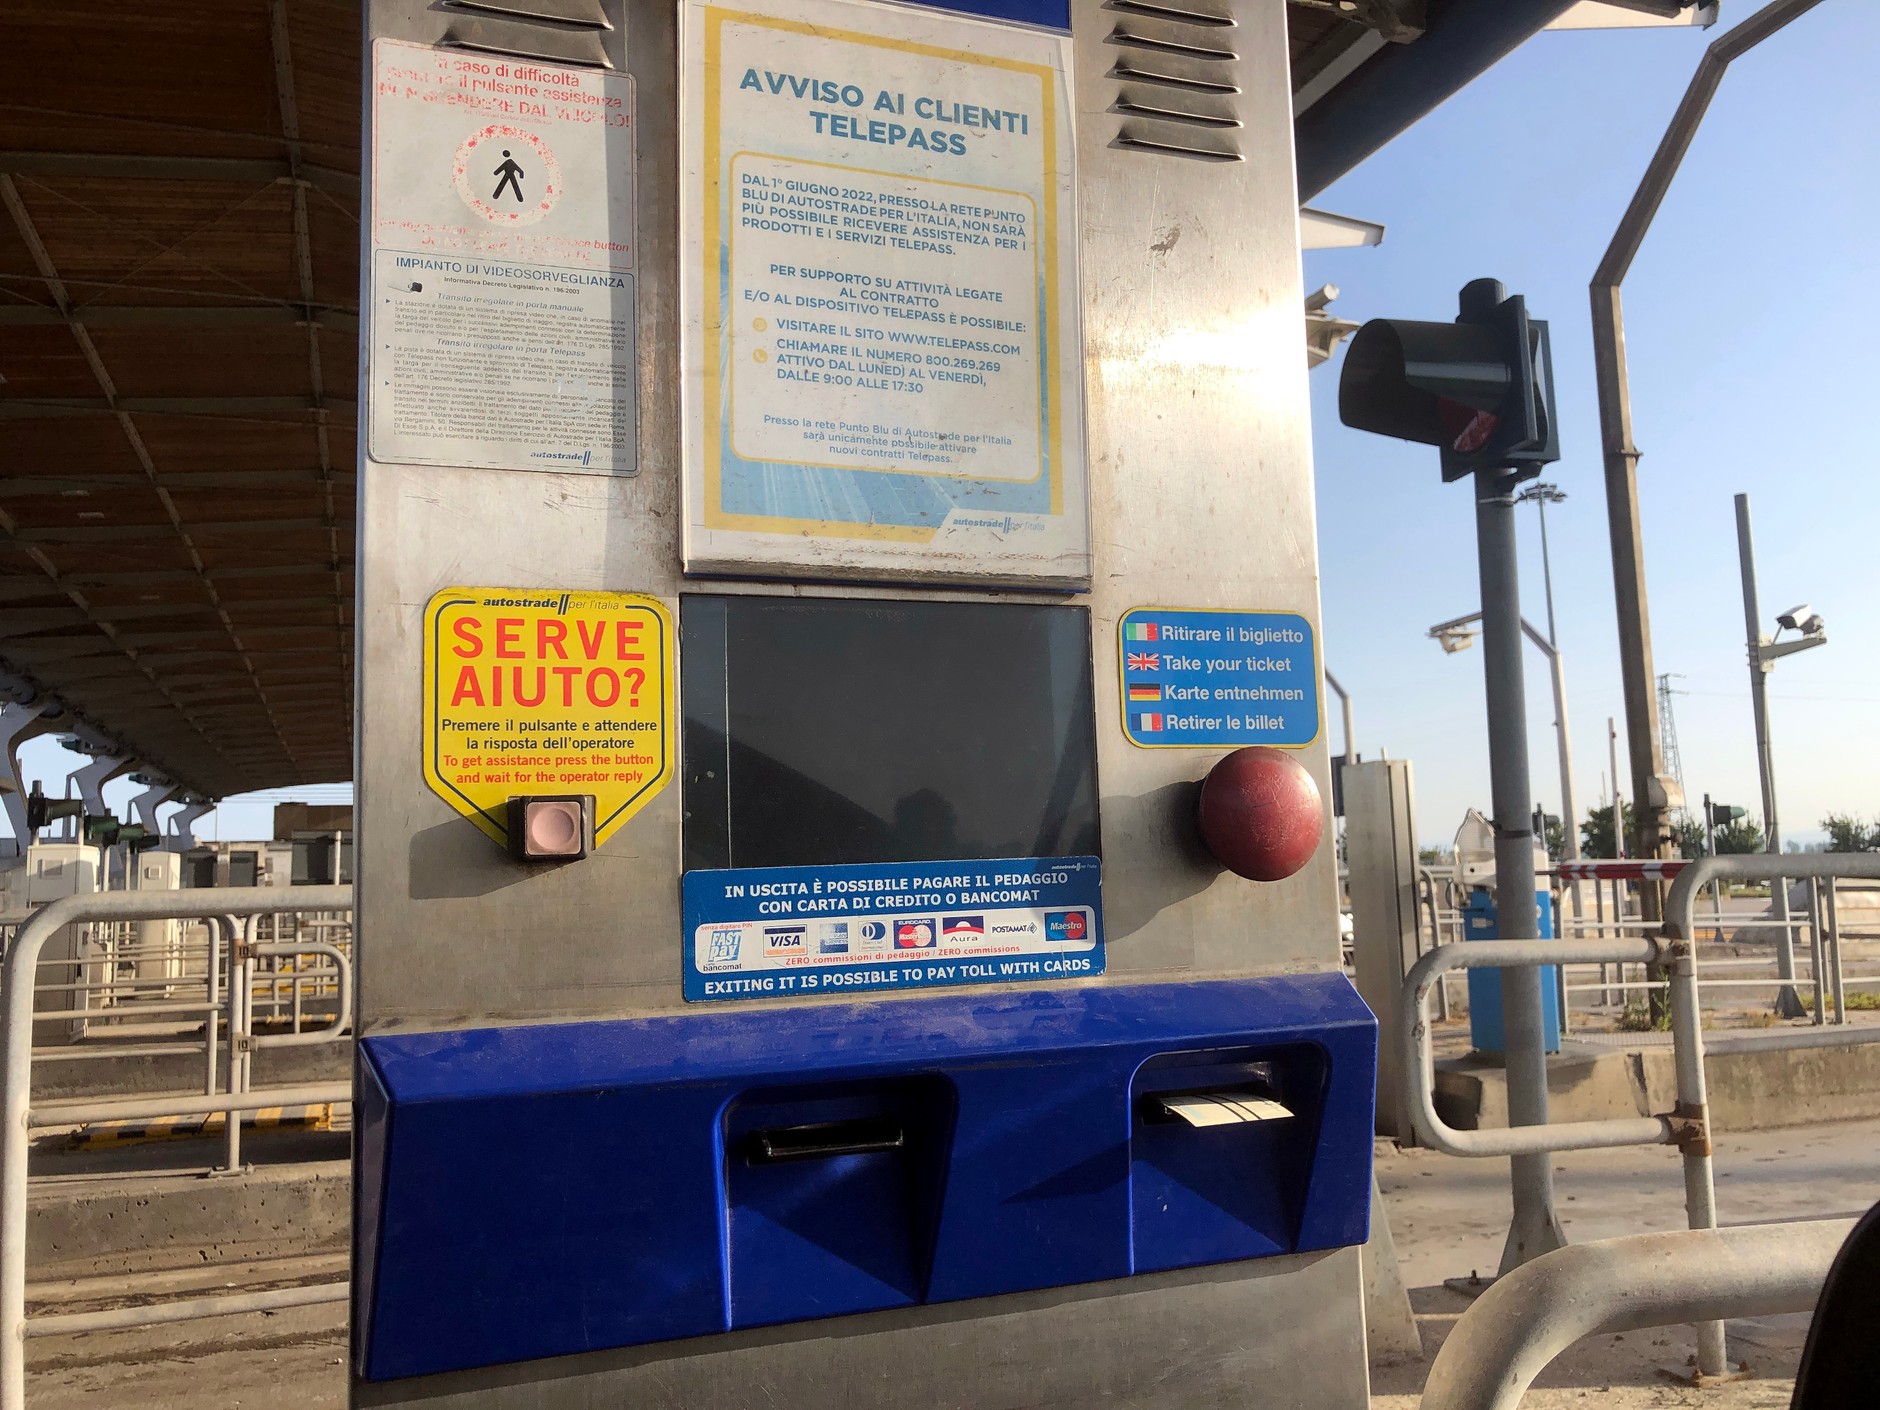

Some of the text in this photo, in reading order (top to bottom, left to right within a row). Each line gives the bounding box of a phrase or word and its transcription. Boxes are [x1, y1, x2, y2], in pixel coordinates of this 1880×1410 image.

[453, 60, 491, 75] caso
[496, 64, 509, 78] di
[514, 67, 580, 88] difficoltà
[740, 69, 1027, 135] AVVISO AI CLIENTI
[810, 111, 966, 155] TELEPASS
[743, 174, 769, 186] DAL
[786, 181, 839, 196] GIUGNO
[842, 189, 876, 205] 2022,
[879, 194, 932, 209] PRESSO
[931, 201, 947, 212] LA
[951, 204, 983, 217] RETE
[984, 209, 1025, 223] PUNTO
[743, 188, 768, 200] BLU
[772, 192, 784, 203] DI
[788, 195, 876, 216] AUTOSTRADE
[880, 208, 903, 219] PER
[963, 220, 990, 231] NON
[993, 223, 1025, 236] SARÀ
[743, 202, 764, 214] PIÙ
[770, 207, 838, 225] POSSIBILE
[844, 217, 907, 234] RICEVERE
[913, 227, 989, 246] ASSISTENZA
[995, 238, 1017, 249] PER
[743, 217, 811, 235] PRODOTTI
[816, 228, 823, 237] E
[836, 230, 885, 245] SERVIZI
[890, 237, 955, 254] TELEPASS.
[594, 239, 630, 252] button
[397, 258, 624, 287] IMPIANTO DI VIDEOSORVEGLIANZA
[771, 264, 1002, 302] PER SUPPORTO SU ATTIVITÀ LEGATE
[840, 288, 939, 308] AL CONTRATTO
[745, 290, 1025, 332] E/O AL DISPOSITIVO TELEPASS È POSSIBILE:
[777, 319, 1020, 355] VISITARE IL SITO WWW.TELEPASS.COM
[777, 339, 1000, 372] CHIAMARE IL NUMERO 800.269.269
[777, 354, 986, 386] ATTIVO DAL LUNEDÌ AL VENERDÌ,
[778, 369, 923, 393] DALLE 9:00 ALLE 17:30
[764, 415, 799, 426] Presso
[803, 418, 811, 427] la
[815, 421, 835, 429] rete
[840, 422, 869, 432] Punto
[873, 425, 888, 434] Blu
[892, 427, 901, 435] di
[905, 429, 960, 440] Autostrade
[804, 431, 976, 453] sarà unicamente possibile attivare
[830, 446, 952, 463] nuovi contratti Telepass.
[483, 598, 558, 608] autostrade
[452, 616, 645, 661] SERVE
[1161, 626, 1304, 645] Ritirare il biglietto
[1163, 655, 1291, 673] Take your ticket
[451, 665, 646, 707] AIUTO?
[1165, 685, 1304, 700] Karte entnehmen
[442, 719, 657, 734] Premere il pulsante e attendere
[1166, 714, 1284, 730] Retirer le billet
[467, 737, 479, 749] la
[484, 738, 537, 752] risposta
[444, 753, 654, 769] To get assistance press the button
[456, 770, 643, 785] and wait for the operator reply
[725, 873, 1067, 897] IN USCITA È POSSIBILE PAGARE IL PEDAGGIO
[759, 890, 1039, 913] CON CARTA DI CREDITO O BANCOMAT
[992, 925, 1027, 933] POSTAMAT
[1050, 922, 1082, 931] Maestro
[770, 935, 801, 947] VISA
[786, 957, 810, 965] ZERO
[812, 954, 873, 964] commissioni
[887, 951, 930, 960] pedaggio
[938, 948, 962, 956] ZERO
[964, 946, 1021, 955] commissions
[705, 959, 1090, 994] EXITING IT IS POSSIBLE TO PAY TOLL WITH CARDS
